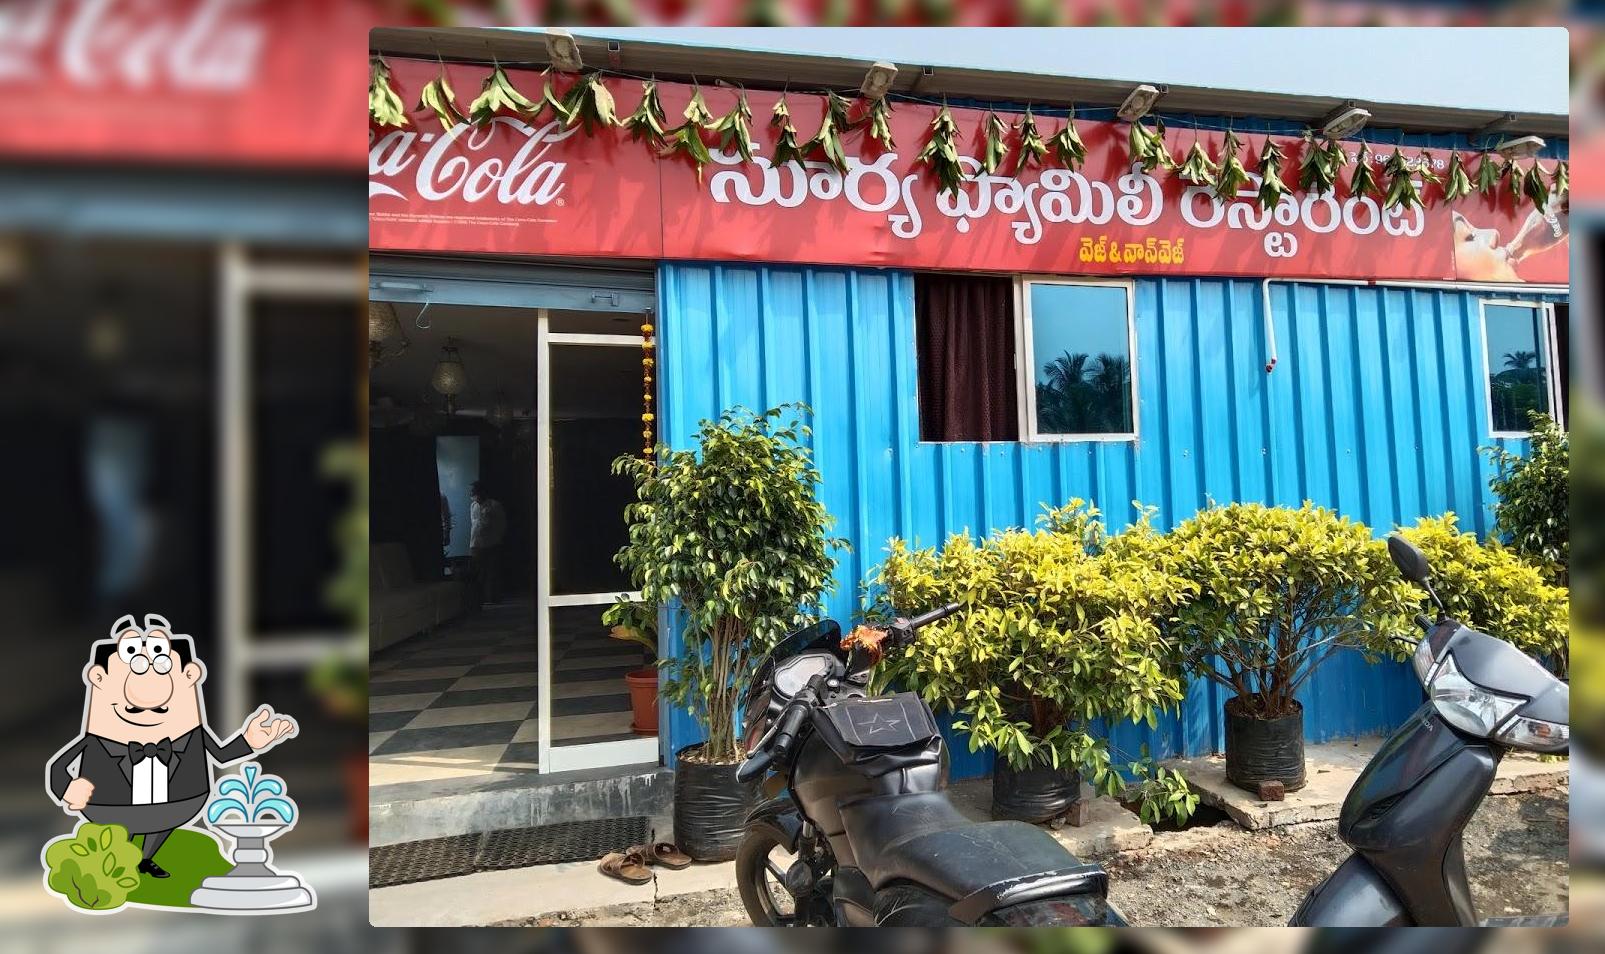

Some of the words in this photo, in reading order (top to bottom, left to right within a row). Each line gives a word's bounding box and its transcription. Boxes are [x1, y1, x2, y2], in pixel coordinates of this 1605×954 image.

[369, 115, 582, 206] a-Cola
[709, 142, 923, 239] సూర్య
[935, 155, 1164, 245] ఫ్యామిలీ
